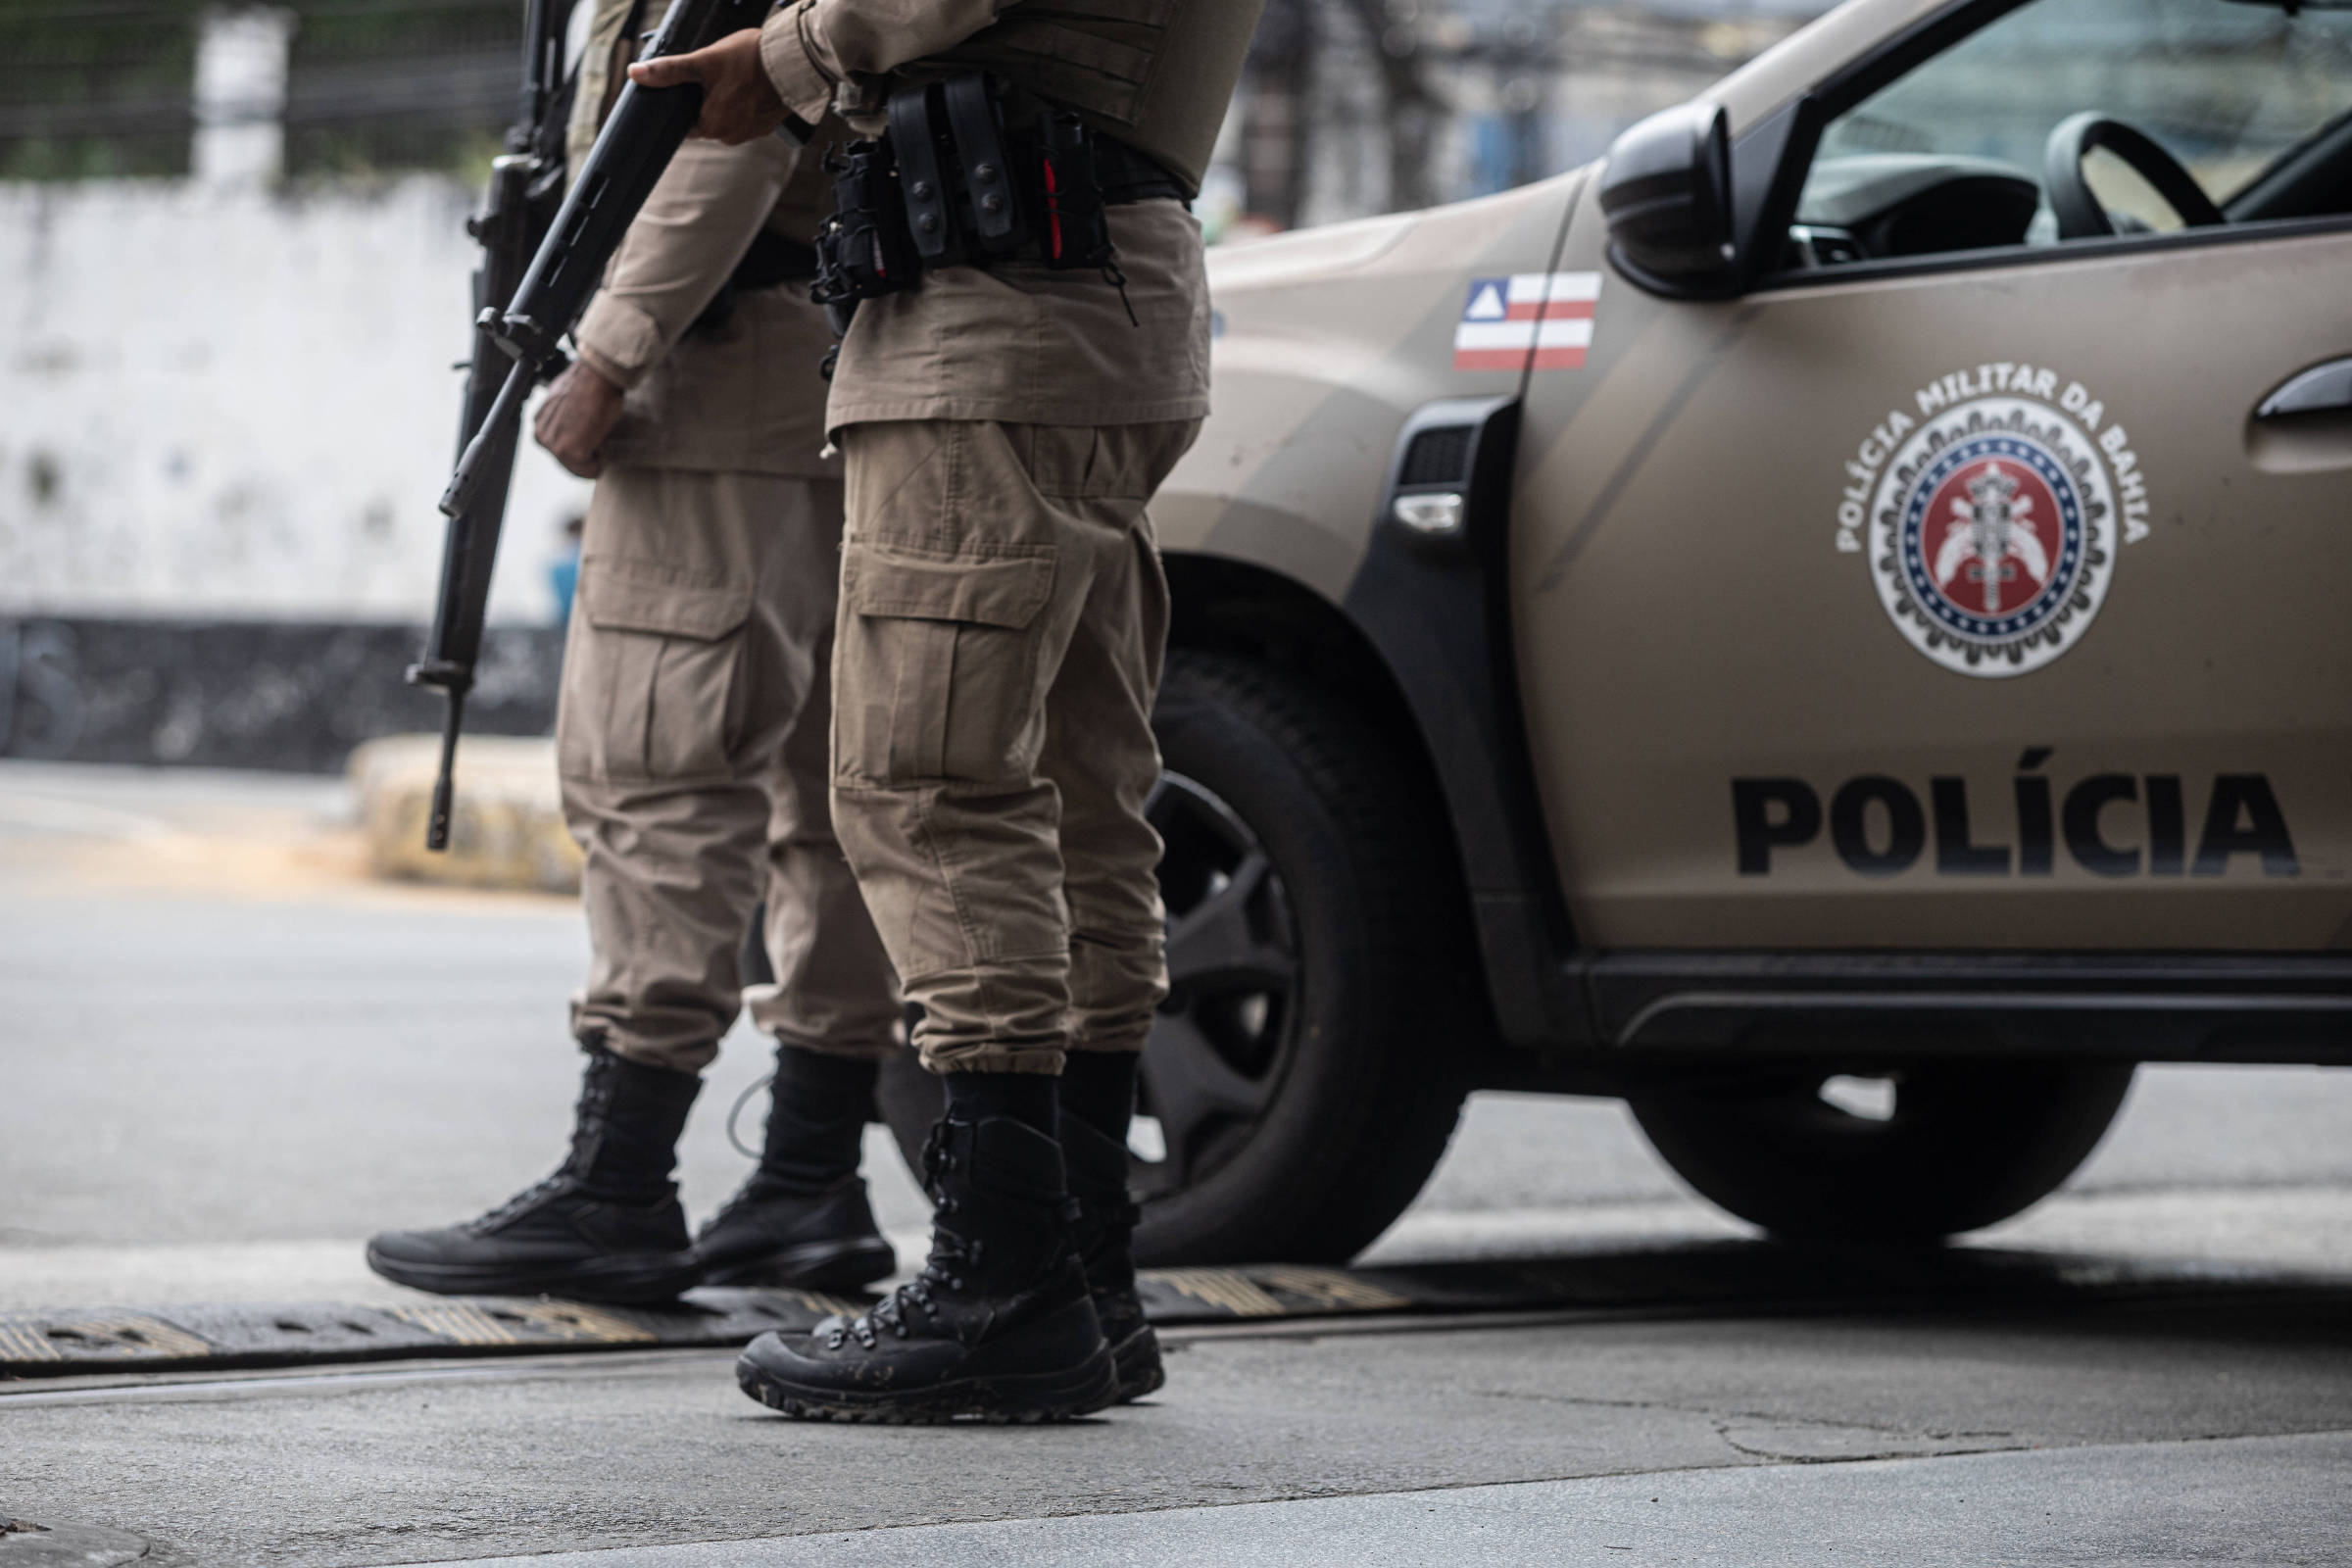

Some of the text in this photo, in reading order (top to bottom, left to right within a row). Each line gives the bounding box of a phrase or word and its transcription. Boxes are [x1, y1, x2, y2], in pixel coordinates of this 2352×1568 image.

[1836, 363, 2150, 553] POLÍCIA MILITAR DA BAHIA
[1730, 747, 2299, 878] POLÍCIA
